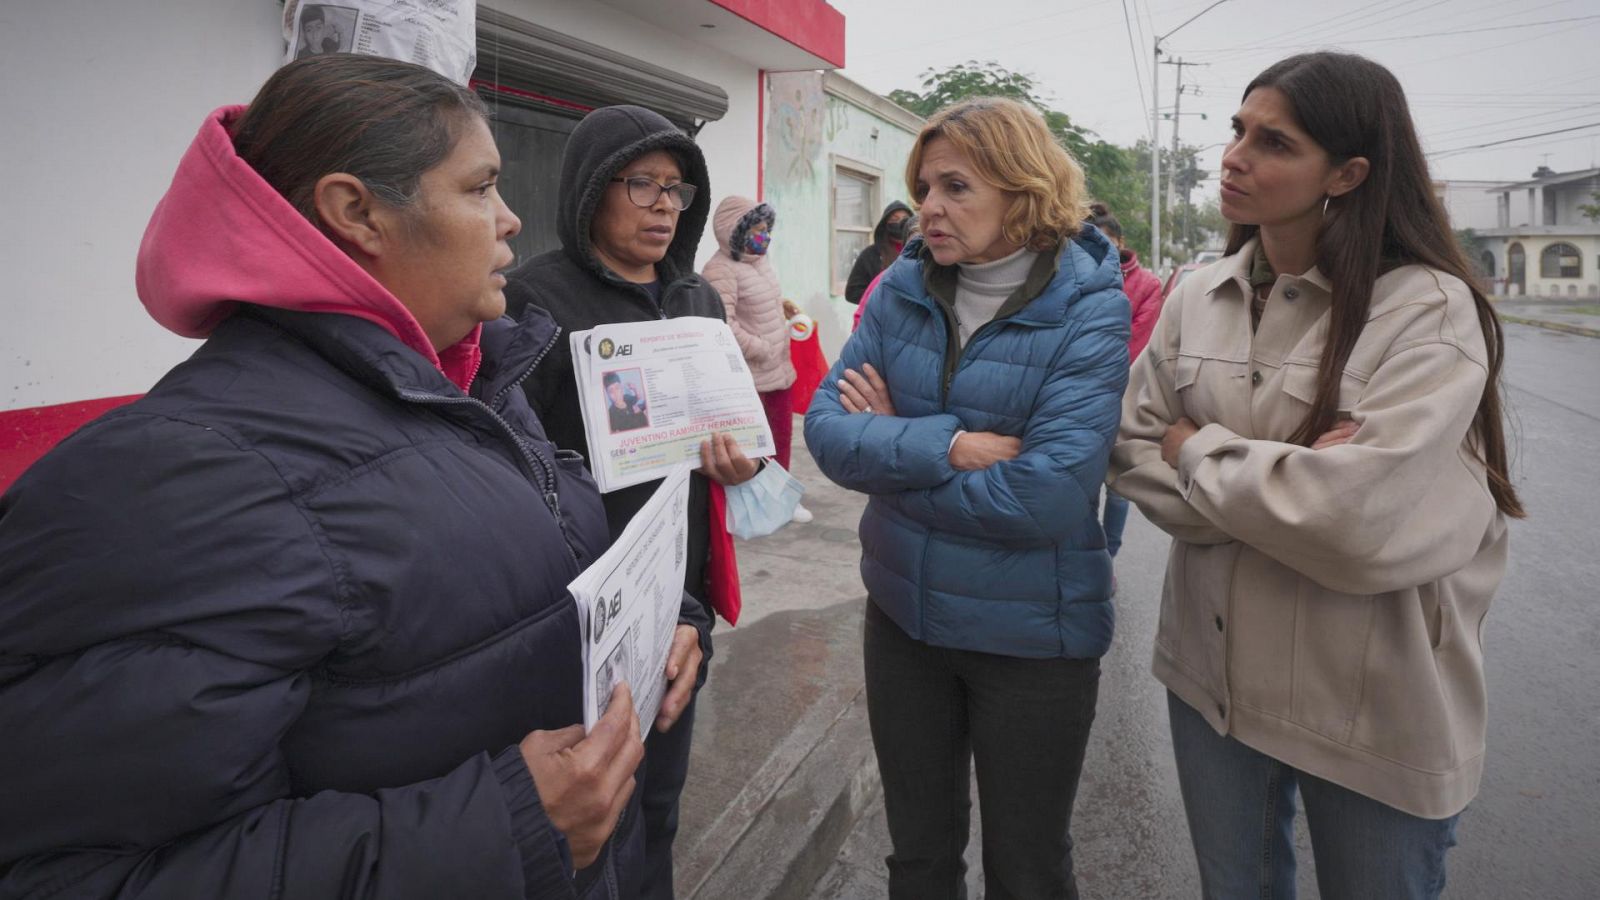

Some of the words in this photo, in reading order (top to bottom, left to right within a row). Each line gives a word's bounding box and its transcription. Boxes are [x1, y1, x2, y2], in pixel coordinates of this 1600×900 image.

[615, 344, 633, 357] AEI
[620, 431, 668, 447] JUVENTINO
[669, 424, 706, 438] RAMIREZ
[606, 588, 622, 627] AEI
